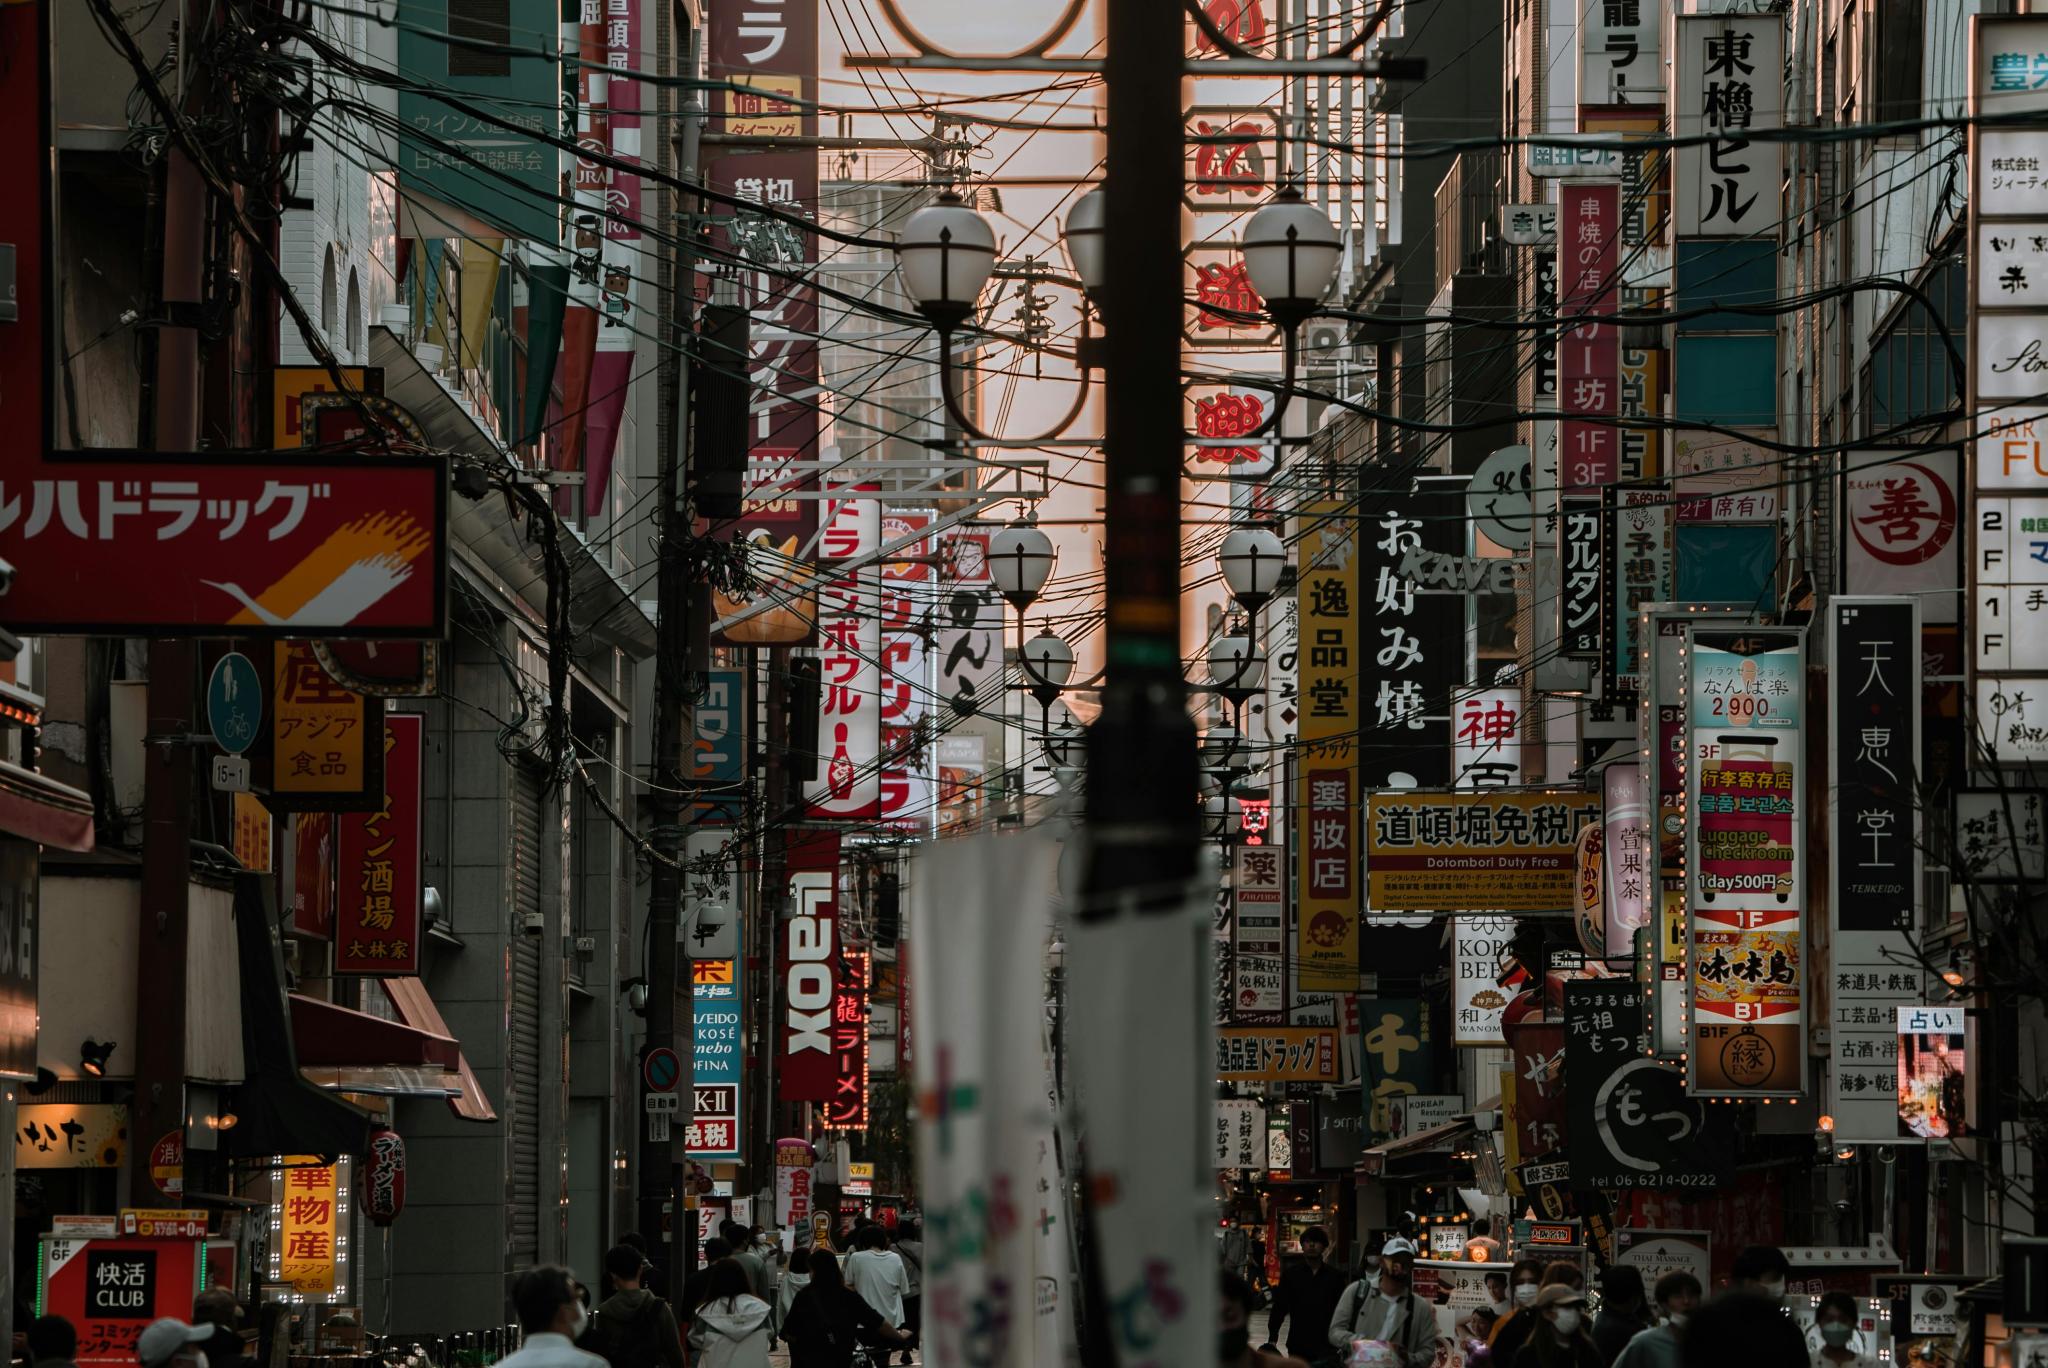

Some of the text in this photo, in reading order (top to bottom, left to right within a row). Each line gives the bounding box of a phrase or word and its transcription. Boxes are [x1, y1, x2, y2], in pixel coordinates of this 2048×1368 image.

[1991, 156, 2039, 173] 株式会社
[1575, 197, 1602, 292] 串焼の店
[1990, 417, 2037, 439] BAR
[1574, 431, 1607, 453] 1F
[1573, 463, 1606, 485] 3F
[1713, 496, 1774, 519] 席有り
[1855, 477, 1942, 545] 善
[1400, 544, 1518, 595] KAVE
[1566, 512, 1600, 630] カルダン
[1375, 510, 1426, 731] お好み焼
[1309, 579, 1350, 718] 逸品堂
[1703, 678, 1789, 696] なんば楽
[279, 717, 358, 741] アジア
[1698, 744, 1721, 759] 3F
[1856, 640, 1899, 868] 天恵堂
[290, 750, 348, 778] 食品
[216, 764, 244, 786] 15-1
[1698, 829, 1770, 846] Luggage
[1427, 856, 1560, 871] Dotombori Duty Free
[1702, 846, 1795, 861] Checkroom
[1243, 852, 1276, 885] 薬
[1735, 911, 1764, 929] 1F
[346, 941, 410, 960] 大林家
[1733, 1002, 1763, 1020] B1
[1910, 1011, 1952, 1030] 占い
[698, 1026, 735, 1040] KOSÉ
[1570, 1011, 1614, 1036] 元祖
[1699, 1027, 1729, 1039] B1F
[694, 1041, 733, 1054] nebo
[1615, 1084, 1692, 1142] もつ
[1591, 1174, 1609, 1188] tel
[1434, 1232, 1465, 1244] 神戸牛
[51, 1248, 71, 1262] 6F
[95, 1261, 148, 1287] 快活
[284, 1263, 331, 1276] アジア
[95, 1289, 146, 1309] CLUB
